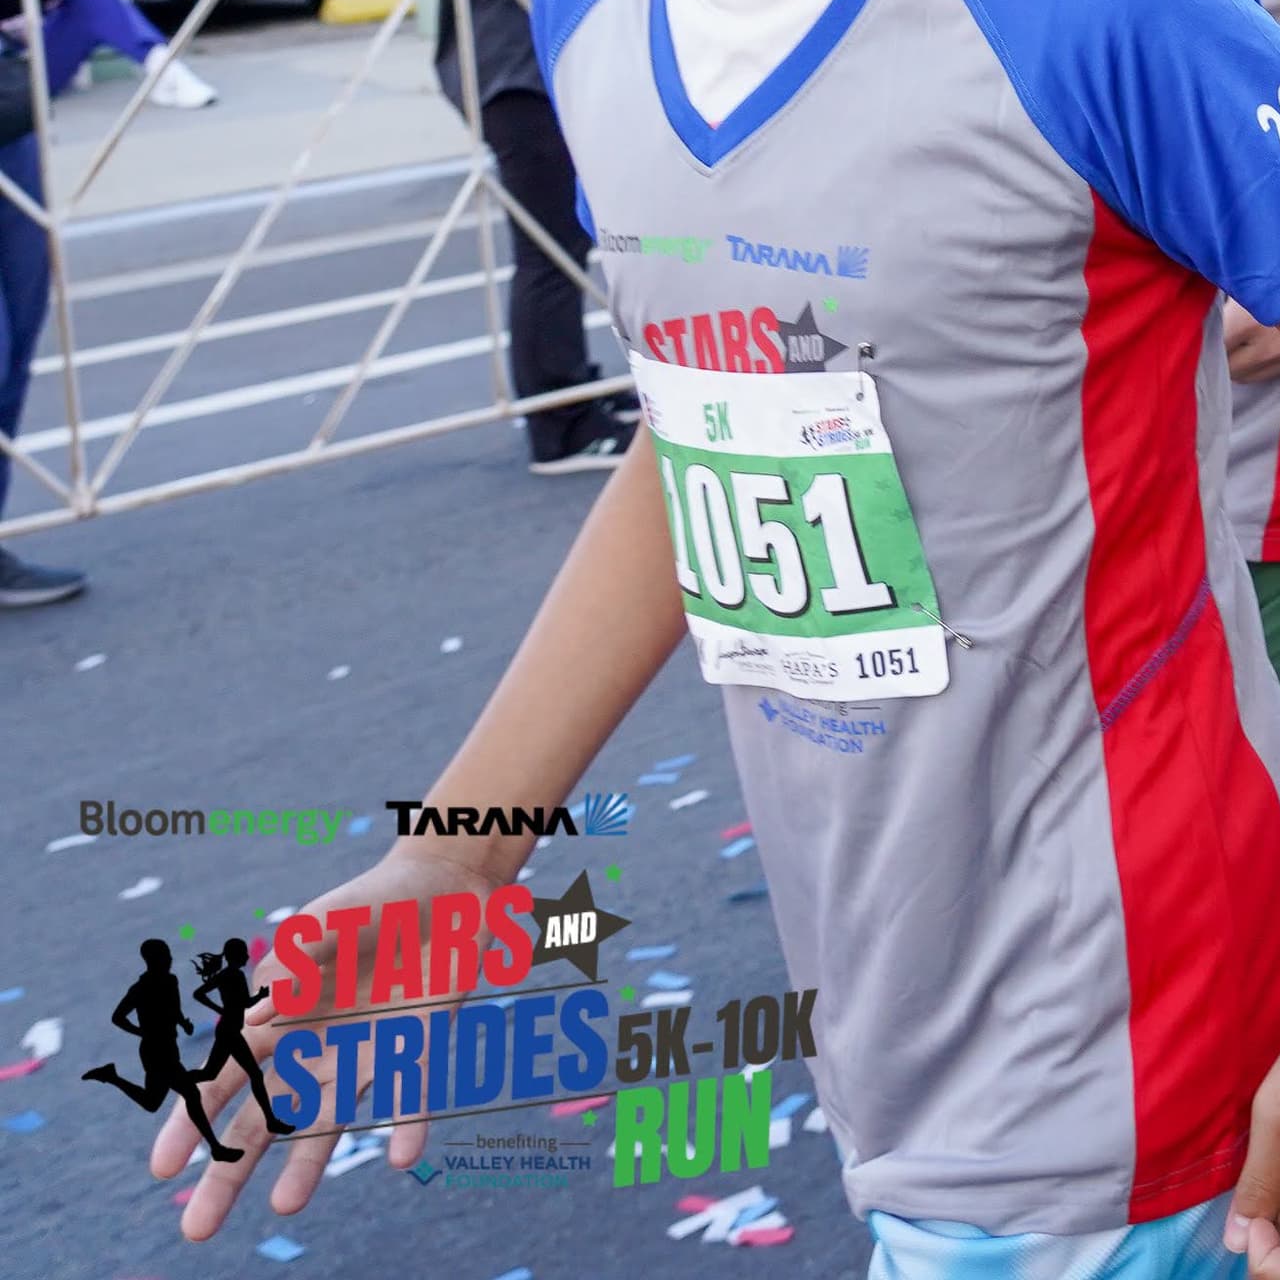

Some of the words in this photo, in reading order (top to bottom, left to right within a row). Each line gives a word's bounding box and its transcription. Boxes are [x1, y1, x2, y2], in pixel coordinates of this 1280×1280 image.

[725, 234, 833, 276] TARANA
[642, 306, 786, 374] STARS
[787, 333, 826, 363] AND
[702, 400, 734, 443] 5K
[661, 454, 899, 619] 1051
[854, 646, 920, 679] 1051
